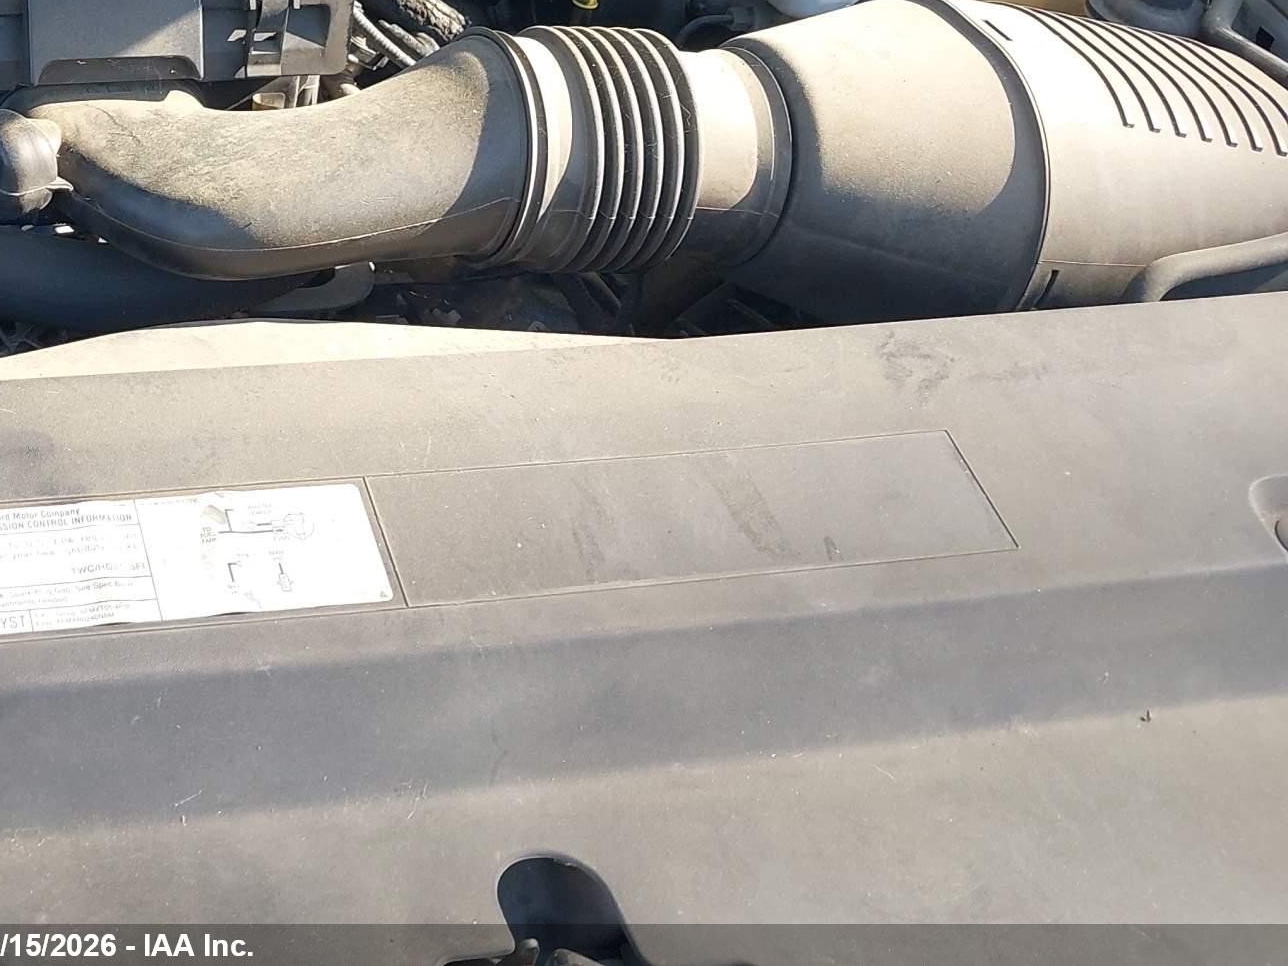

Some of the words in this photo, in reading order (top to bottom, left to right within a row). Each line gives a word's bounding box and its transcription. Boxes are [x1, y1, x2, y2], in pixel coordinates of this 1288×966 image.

[12, 511, 38, 521] Motor
[41, 508, 80, 520] Company
[27, 518, 68, 529] CONTROL
